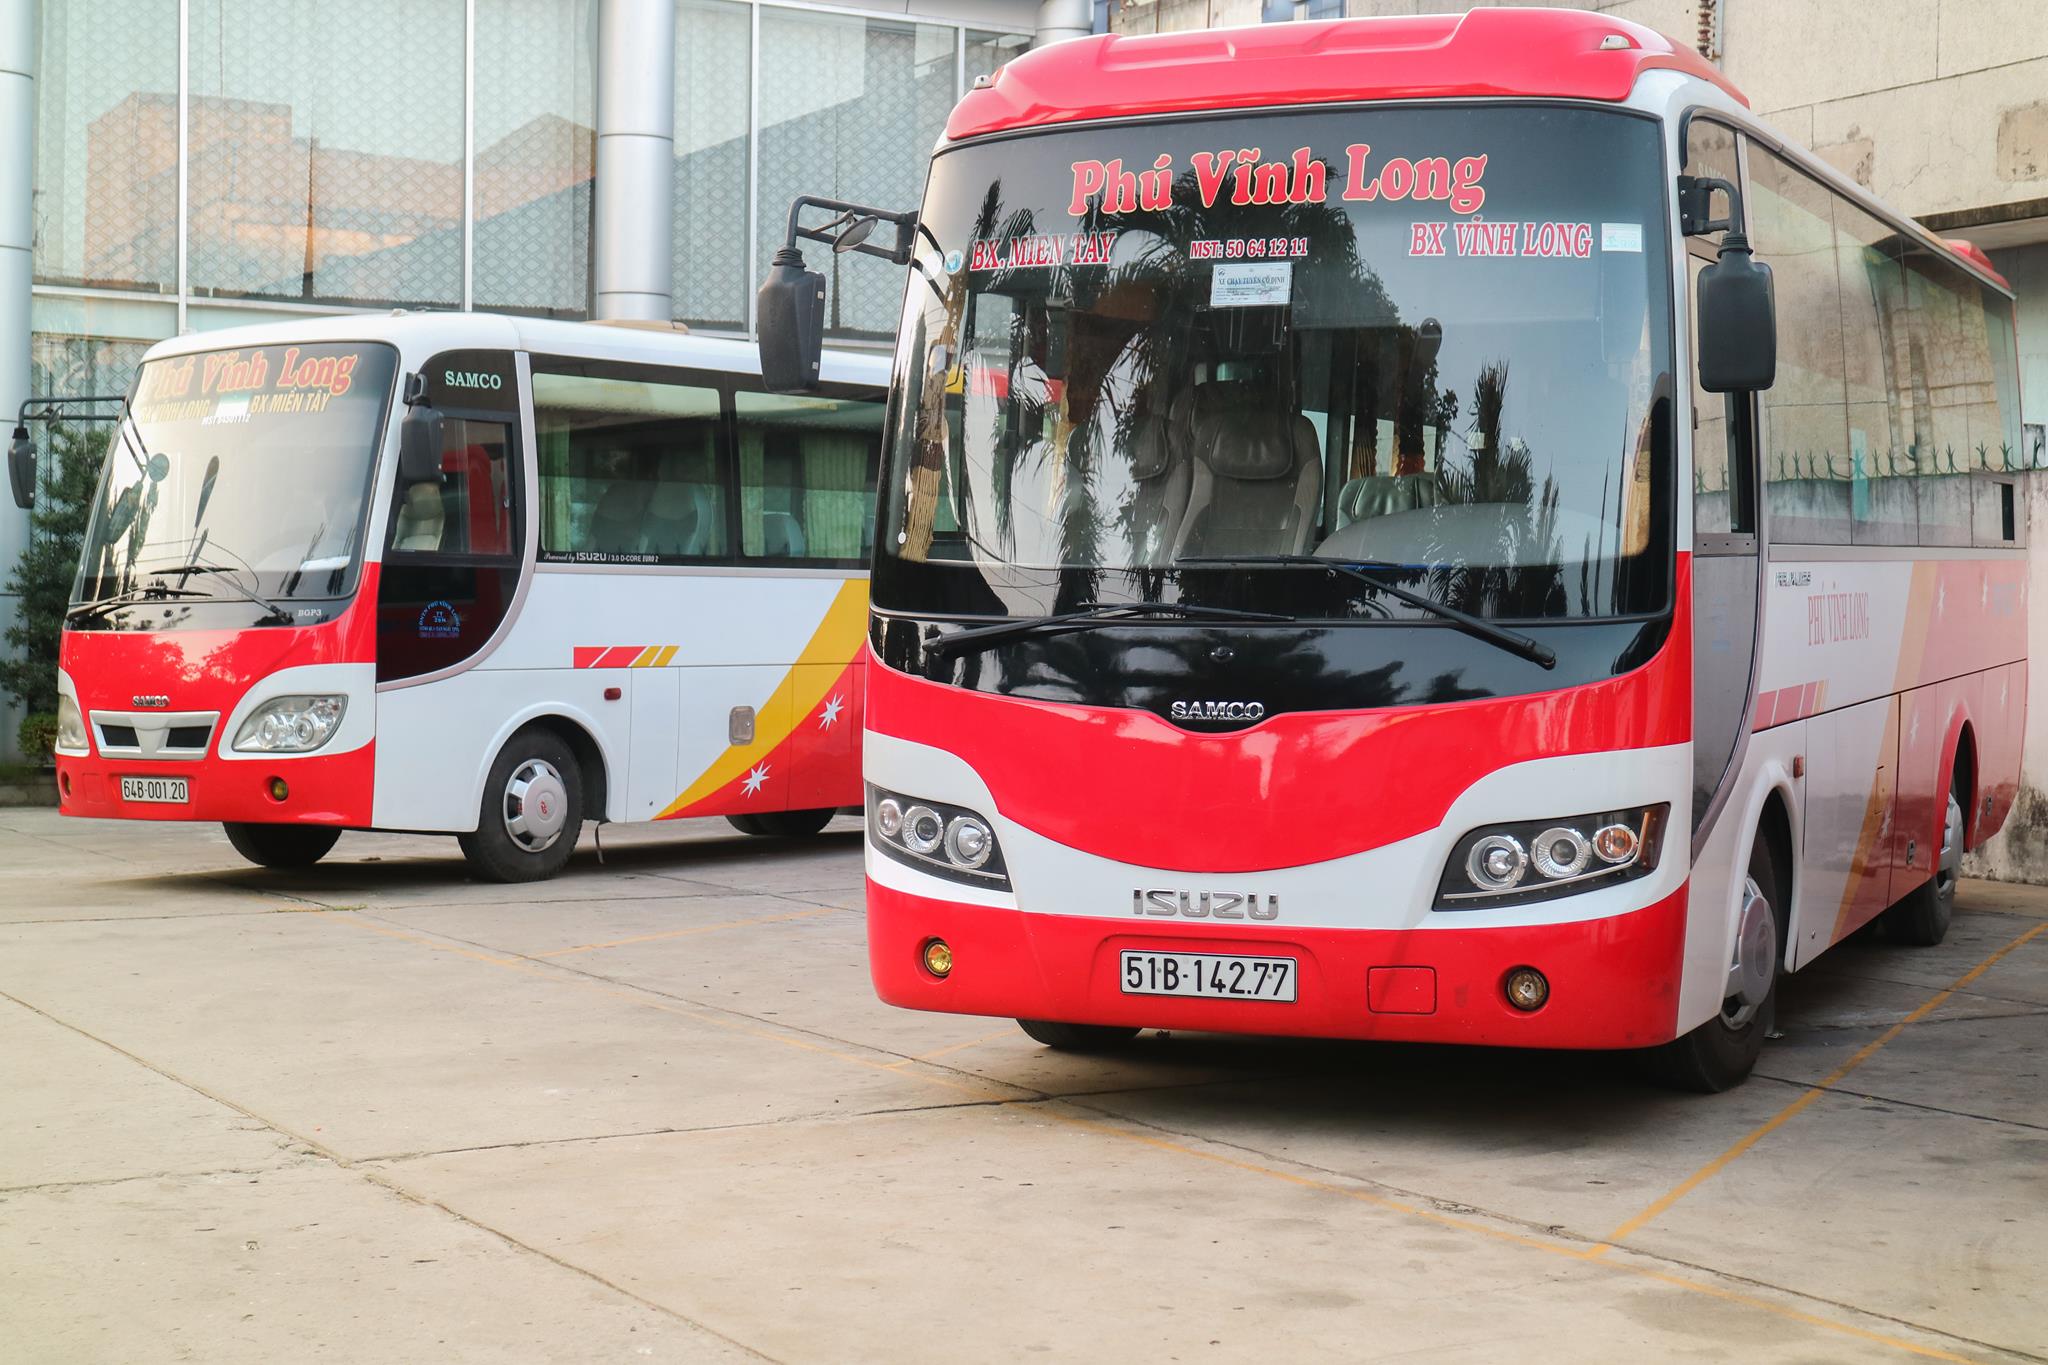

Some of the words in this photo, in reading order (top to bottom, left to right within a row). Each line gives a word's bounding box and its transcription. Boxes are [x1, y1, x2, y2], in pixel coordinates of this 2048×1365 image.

[1067, 154, 1174, 216] Phú
[1191, 146, 1327, 208] Vĩnh
[1342, 143, 1488, 214] Long
[1071, 226, 1117, 265] TÂY
[1189, 240, 1224, 259] MST:
[1225, 238, 1245, 258] 50
[1247, 238, 1266, 258] 64
[1269, 238, 1287, 257] 12
[1289, 237, 1308, 256] 11
[1408, 221, 1447, 257] BX
[1453, 214, 1518, 257] VĨNH
[1522, 221, 1594, 258] LONG
[202, 351, 268, 393] Vĩnh
[276, 347, 358, 396] Long
[445, 370, 502, 390] SAMCO
[251, 394, 269, 413] BX
[269, 386, 304, 413] MIỀN
[305, 389, 330, 412] TÂY
[576, 552, 607, 561] ISUZU
[1849, 591, 1871, 640] LONG
[132, 695, 170, 707] SAMCO
[1171, 700, 1265, 720] SAMCO
[123, 780, 186, 800] 64B-001.20
[1133, 887, 1279, 921] ISUZU
[1126, 956, 1289, 997] 51B-142.77
